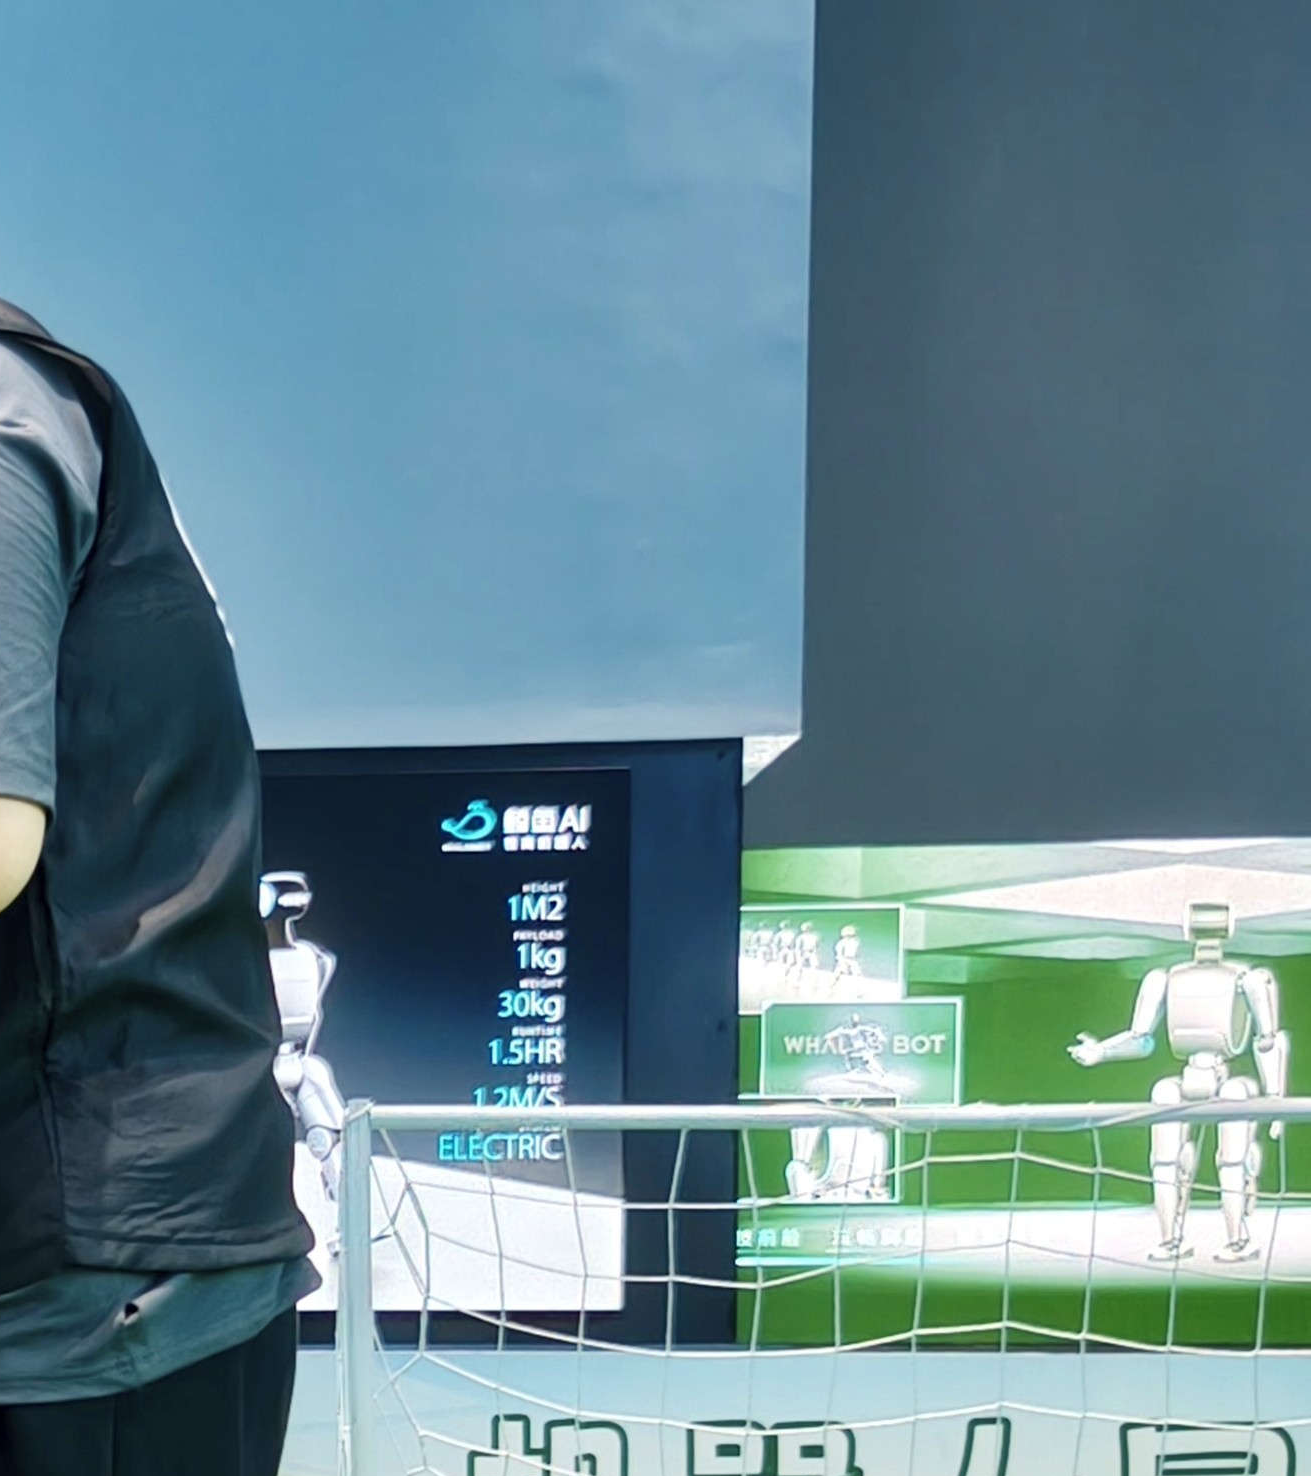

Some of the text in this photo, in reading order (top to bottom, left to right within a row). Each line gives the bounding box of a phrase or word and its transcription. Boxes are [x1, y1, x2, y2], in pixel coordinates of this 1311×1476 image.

[508, 893, 568, 921] 1M2
[513, 928, 567, 941] PAYLOAD
[517, 942, 567, 975] 1kg
[497, 989, 566, 1023] 30kg
[488, 1038, 566, 1064] 1.5HR
[893, 1033, 946, 1055] BOT
[527, 1071, 564, 1084] SPEED
[473, 1085, 565, 1106] 12M/S
[439, 1132, 564, 1160] ELECTRIC
